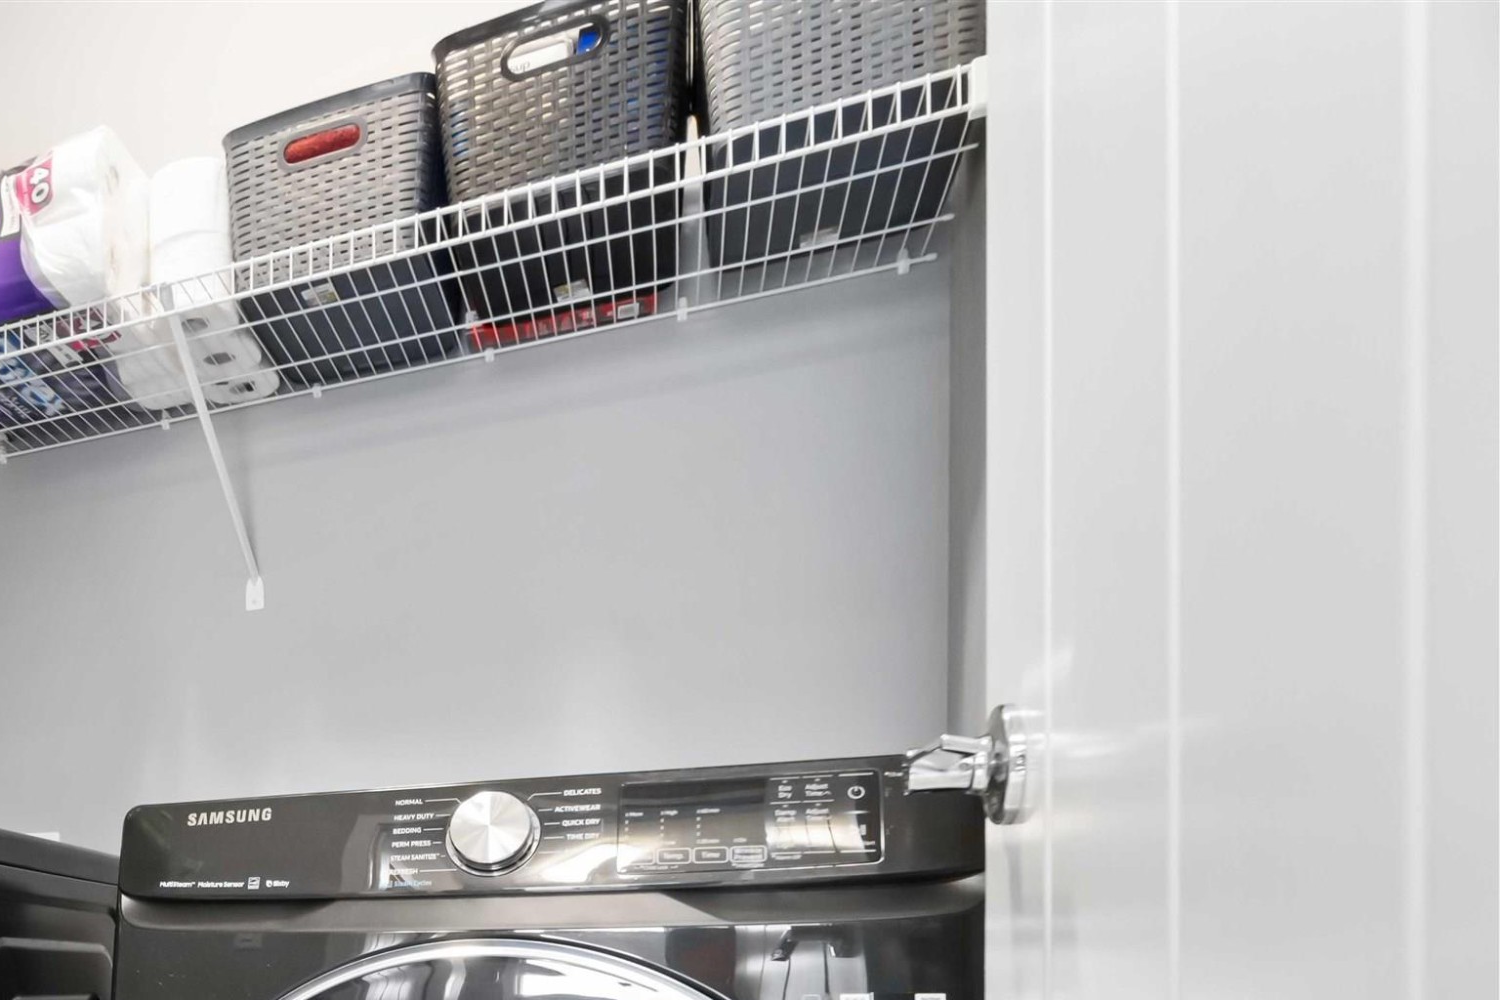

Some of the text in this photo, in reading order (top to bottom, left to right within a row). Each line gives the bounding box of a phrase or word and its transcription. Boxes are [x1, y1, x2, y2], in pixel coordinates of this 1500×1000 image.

[28, 167, 50, 204] 40
[563, 787, 602, 796] DELICATES
[395, 798, 423, 806] NORMAL
[554, 804, 602, 812] ACTIVEWEAR
[187, 807, 272, 827] SAMSUNG
[393, 812, 435, 821] HEAVY DUTY
[562, 819, 585, 827] QUICK
[392, 826, 422, 835] BEDDING
